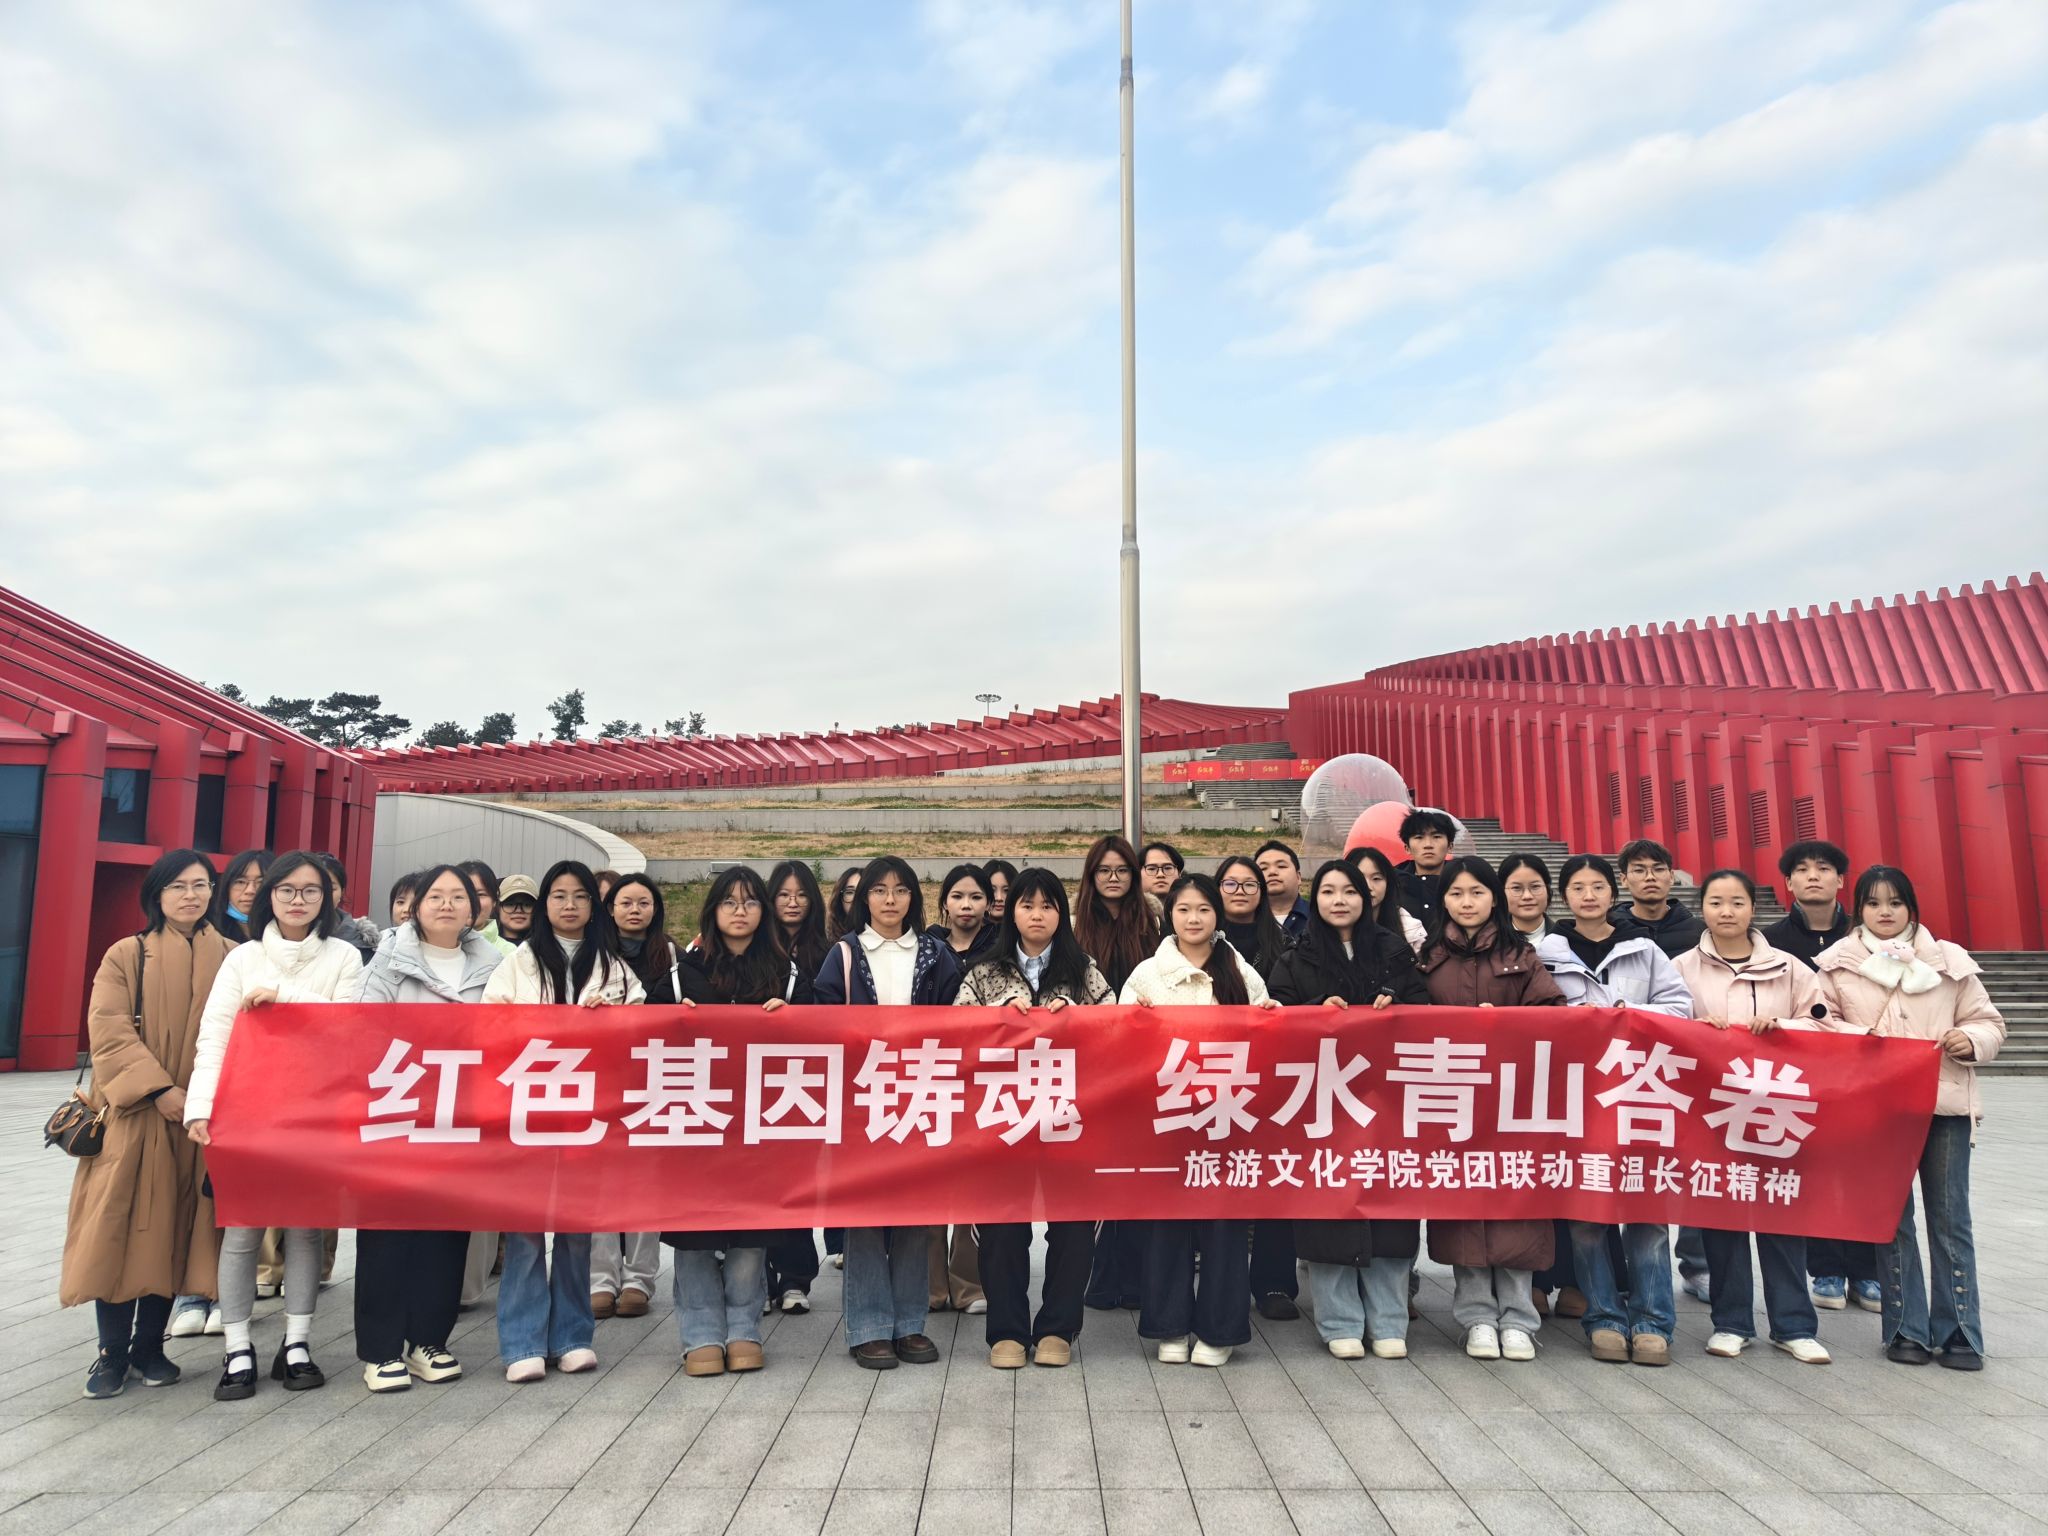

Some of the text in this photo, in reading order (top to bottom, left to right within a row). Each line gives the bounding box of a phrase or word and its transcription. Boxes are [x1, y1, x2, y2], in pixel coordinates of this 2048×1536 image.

[359, 1037, 1819, 1159] 红色基因铸魂 绿水青山答卷
